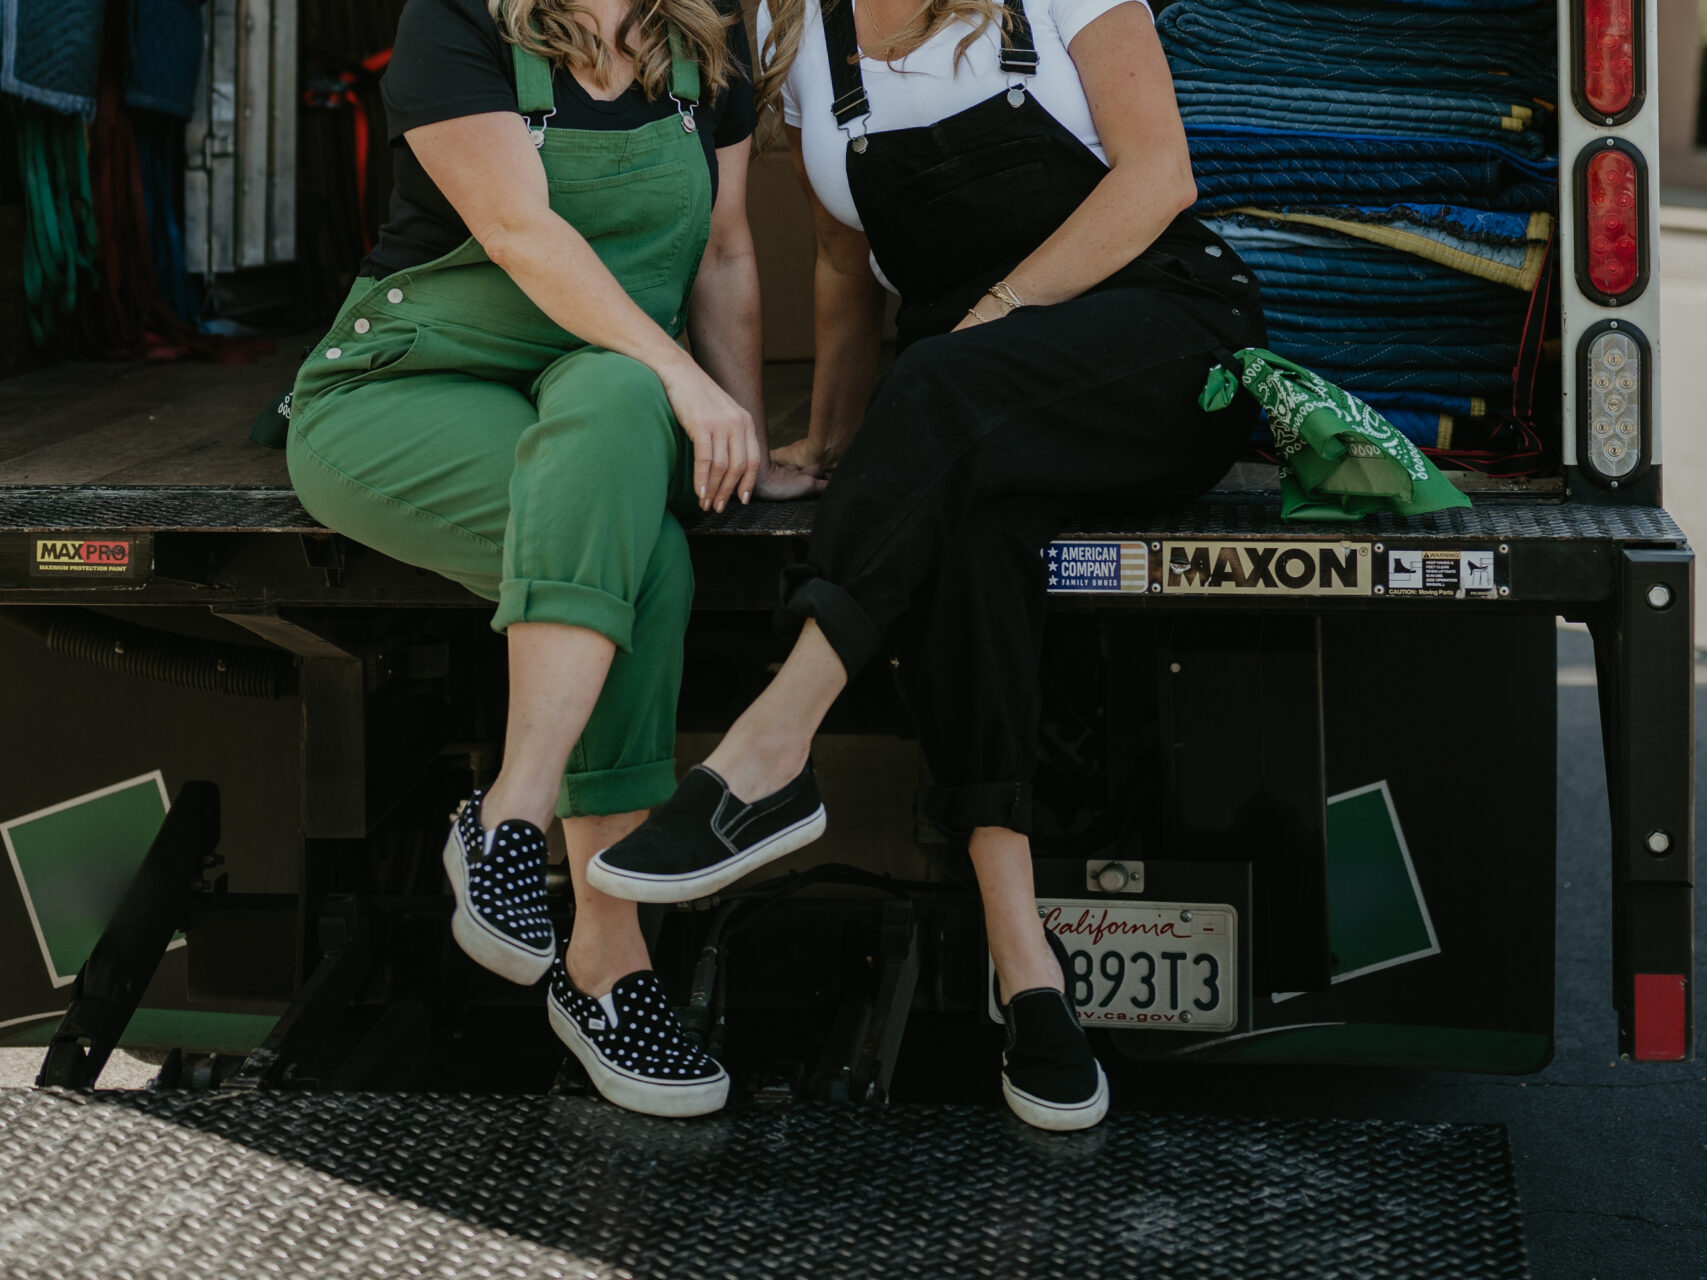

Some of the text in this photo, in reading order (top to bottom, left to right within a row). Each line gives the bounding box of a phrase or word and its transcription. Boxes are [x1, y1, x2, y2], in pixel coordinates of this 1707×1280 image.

[41, 543, 126, 561] MAXPRO
[1061, 547, 1117, 561] AMERICAN
[1061, 561, 1117, 577] COMPANY
[1167, 546, 1358, 589] MAXON
[1061, 579, 1118, 587] FAMILY OWNED
[1418, 589, 1439, 597] Moving
[1042, 907, 1192, 946] California
